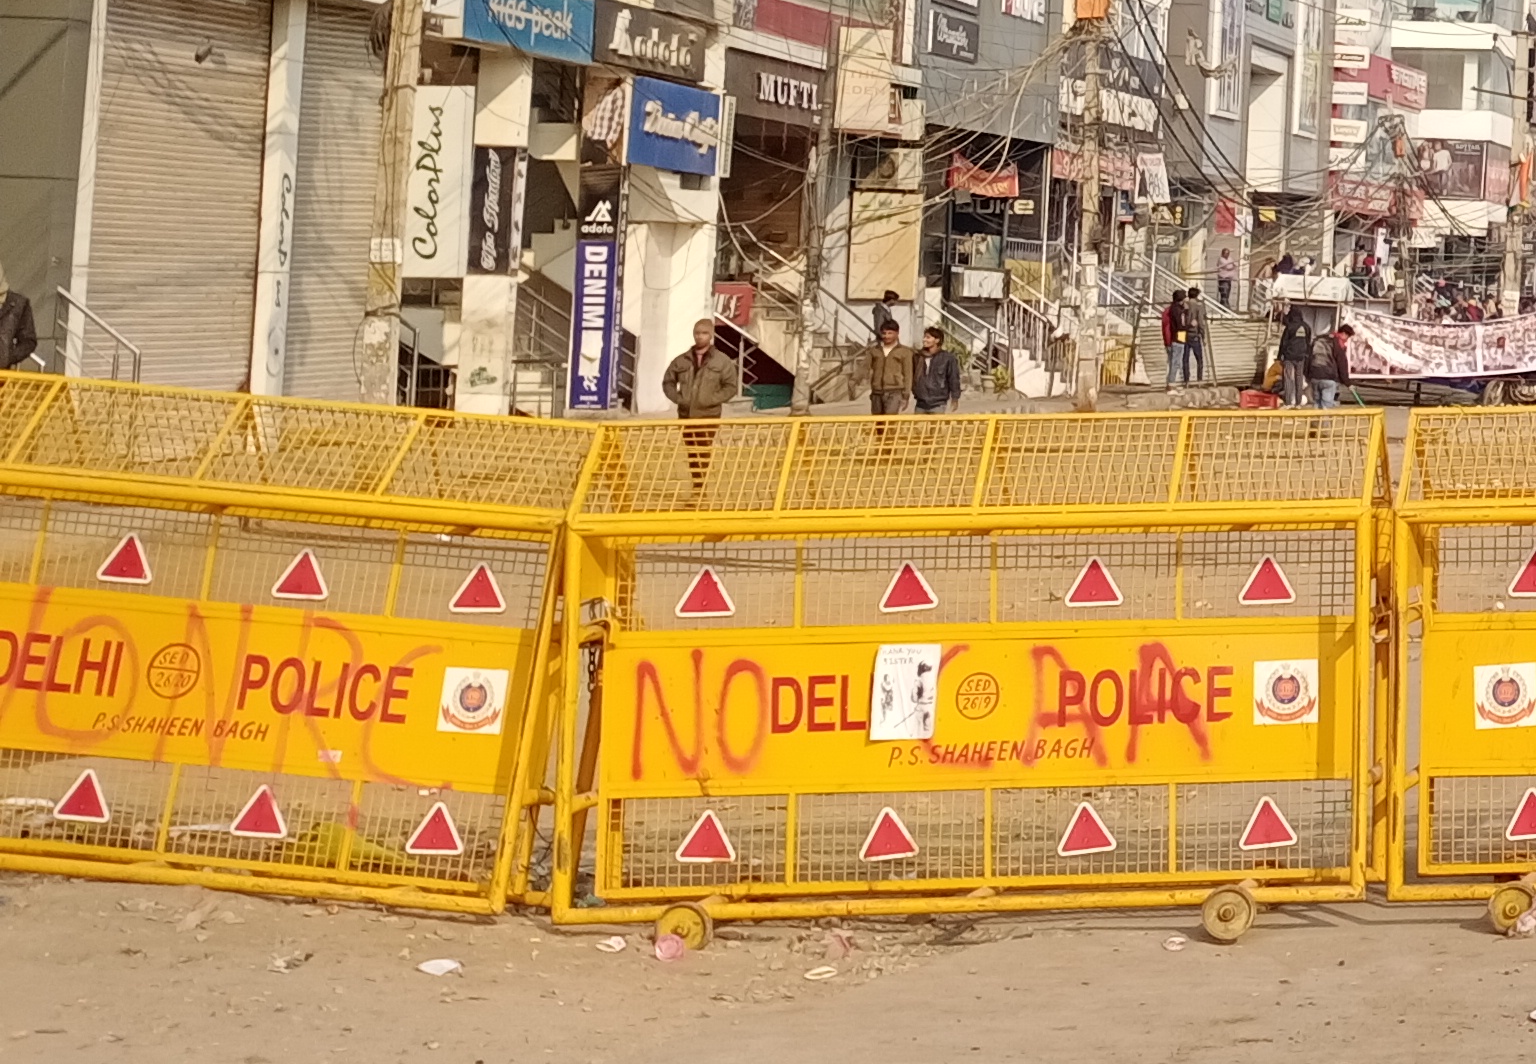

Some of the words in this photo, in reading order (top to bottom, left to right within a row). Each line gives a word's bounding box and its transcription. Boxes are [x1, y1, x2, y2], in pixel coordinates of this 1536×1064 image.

[581, 245, 608, 328] DENIM
[159, 650, 189, 667] SED
[237, 654, 414, 724] POLICE
[771, 675, 868, 735] DEL
[1056, 666, 1234, 728] POLICE
[964, 678, 992, 693] SED
[213, 720, 269, 742] BAGH
[631, 647, 769, 781] NO
[1034, 737, 1097, 761] BAGH
